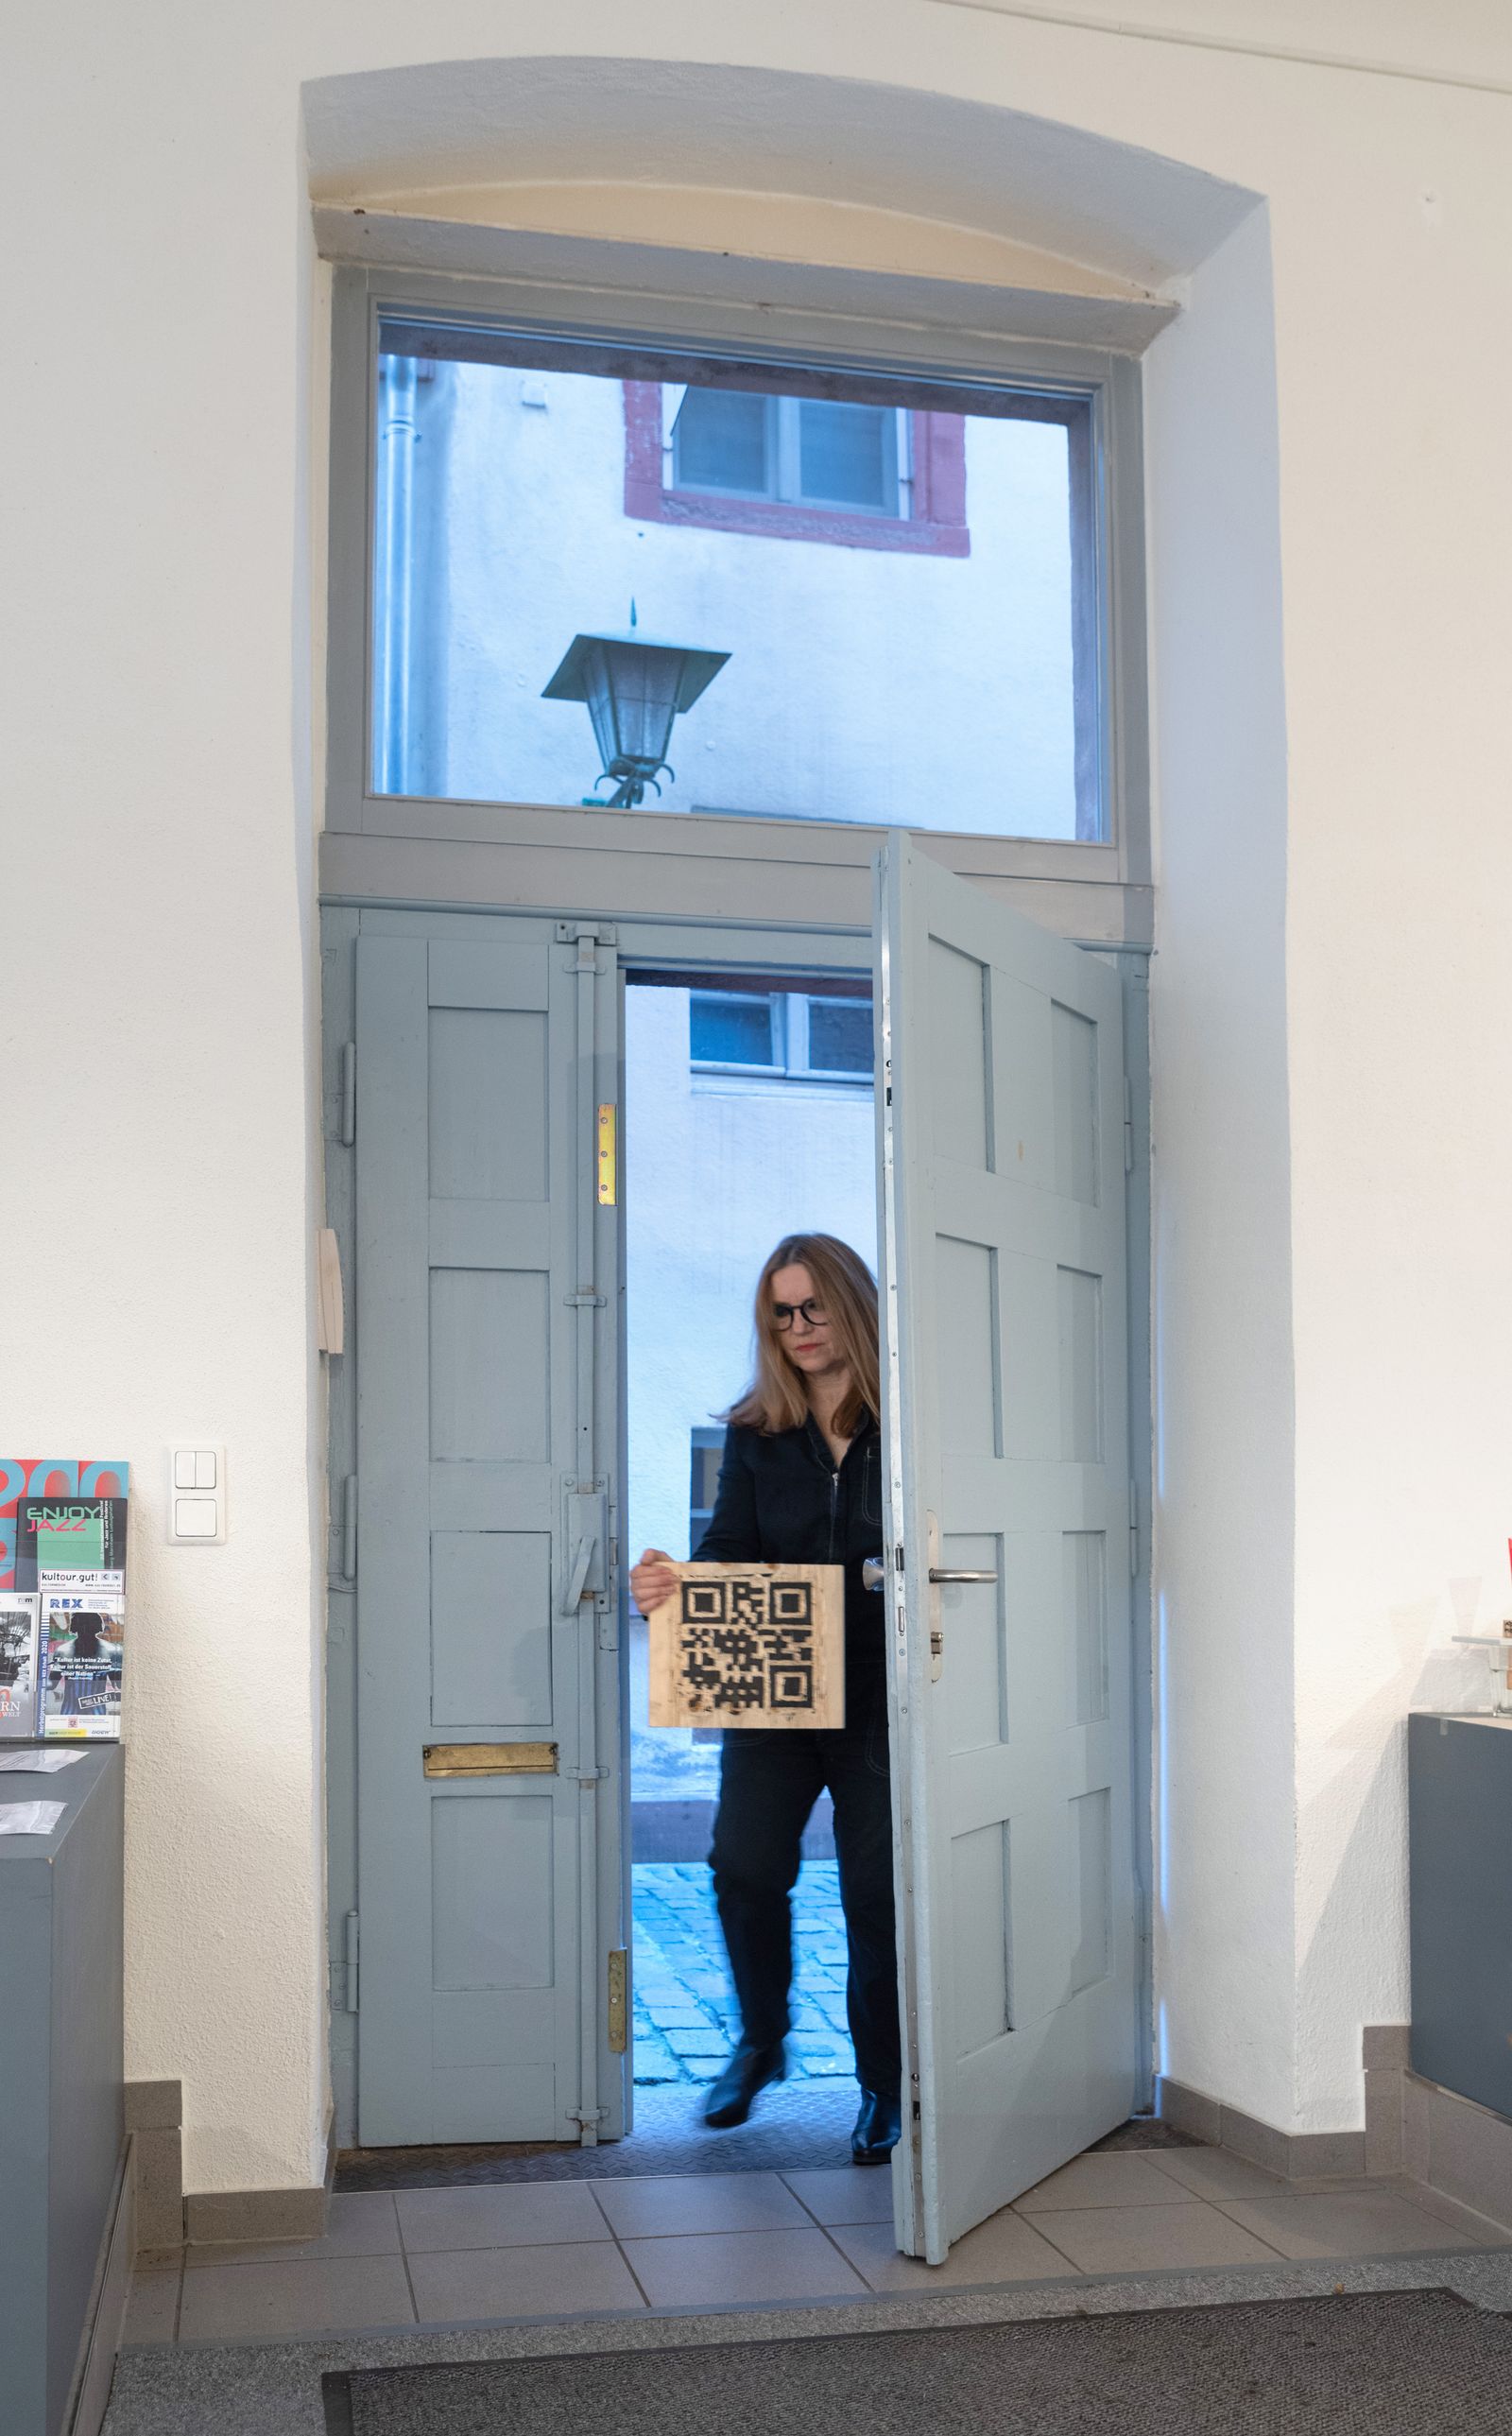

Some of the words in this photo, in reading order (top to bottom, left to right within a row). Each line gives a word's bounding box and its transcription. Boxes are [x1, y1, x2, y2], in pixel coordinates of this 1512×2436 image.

[26, 1506, 100, 1520] ENJOY
[26, 1519, 86, 1532] JAZZ
[42, 1572, 98, 1583] kultour.gut!
[50, 1598, 83, 1609] REX
[0, 1701, 21, 1712] RN
[38, 1687, 46, 1734] Herbstprogramm
